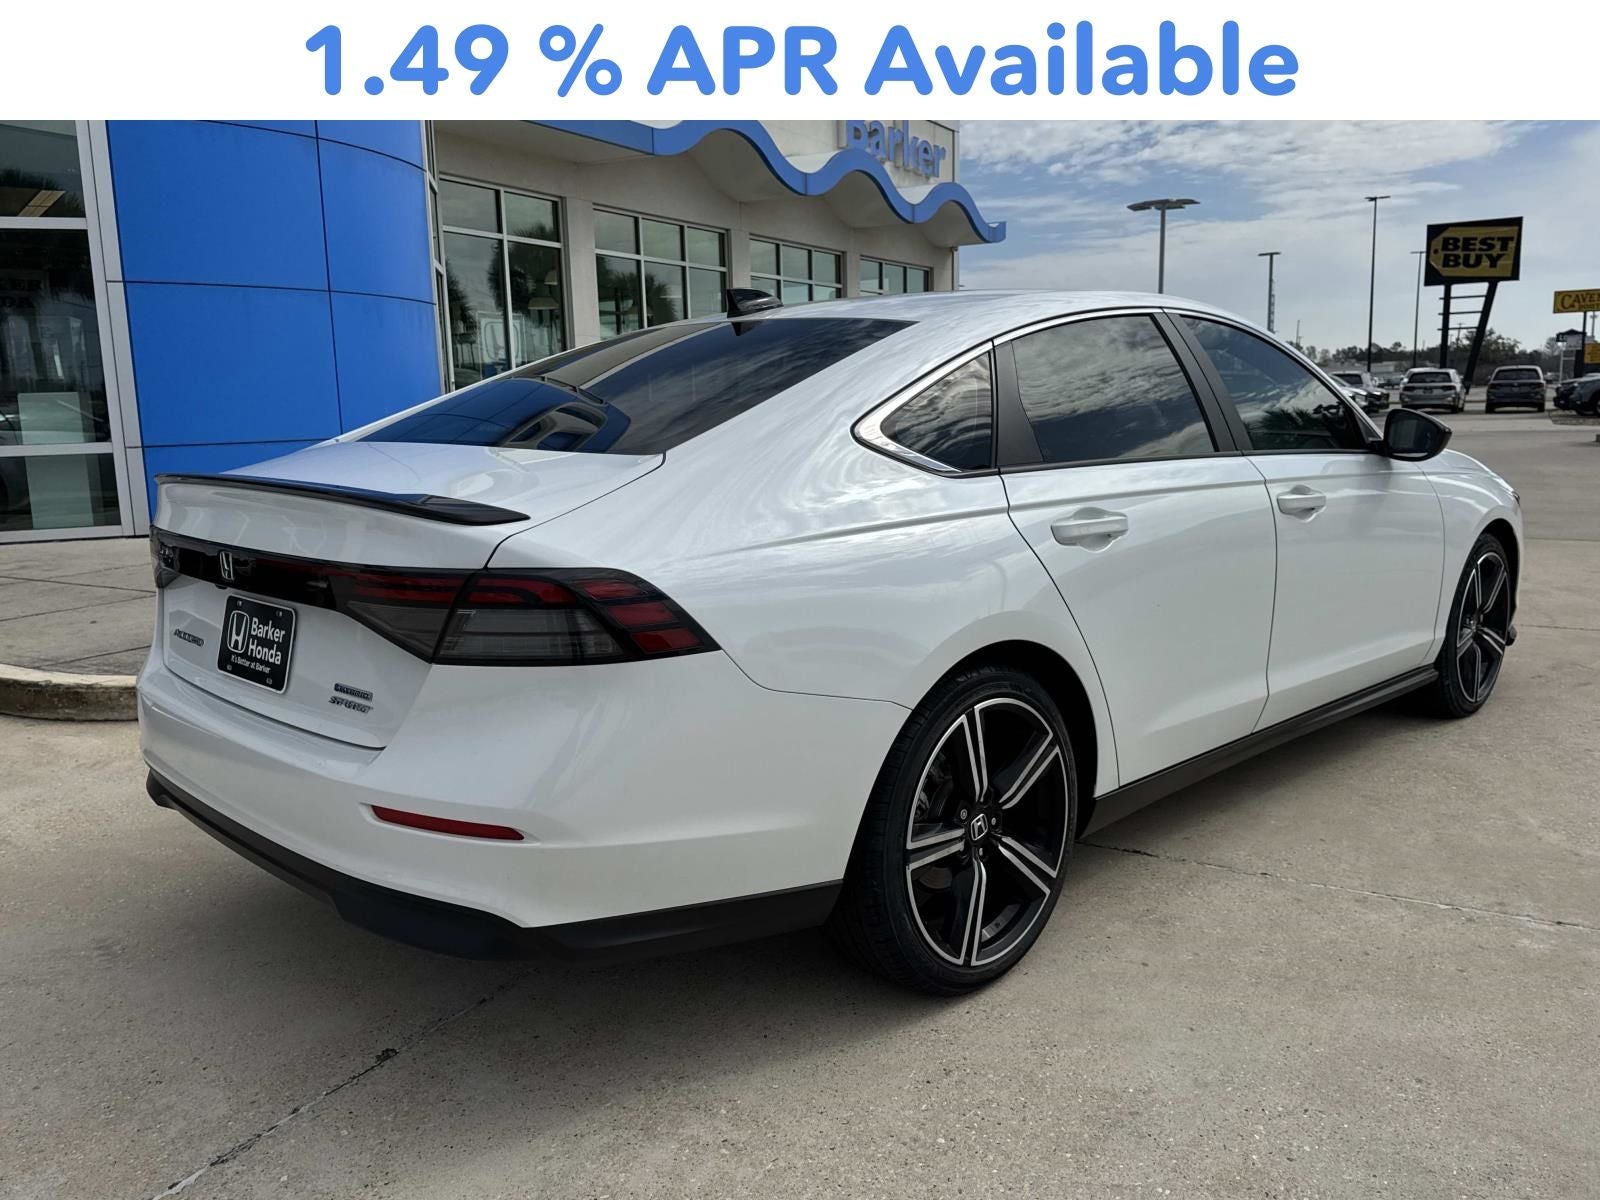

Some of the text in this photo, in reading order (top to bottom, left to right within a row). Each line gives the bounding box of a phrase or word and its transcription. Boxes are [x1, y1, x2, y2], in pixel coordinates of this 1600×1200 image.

[847, 119, 947, 178] Barker
[1441, 236, 1515, 252] BEST
[1441, 253, 1506, 269] BUY
[1561, 293, 1600, 310] CAVE
[250, 617, 286, 643] Barker
[248, 638, 282, 665] Honda
